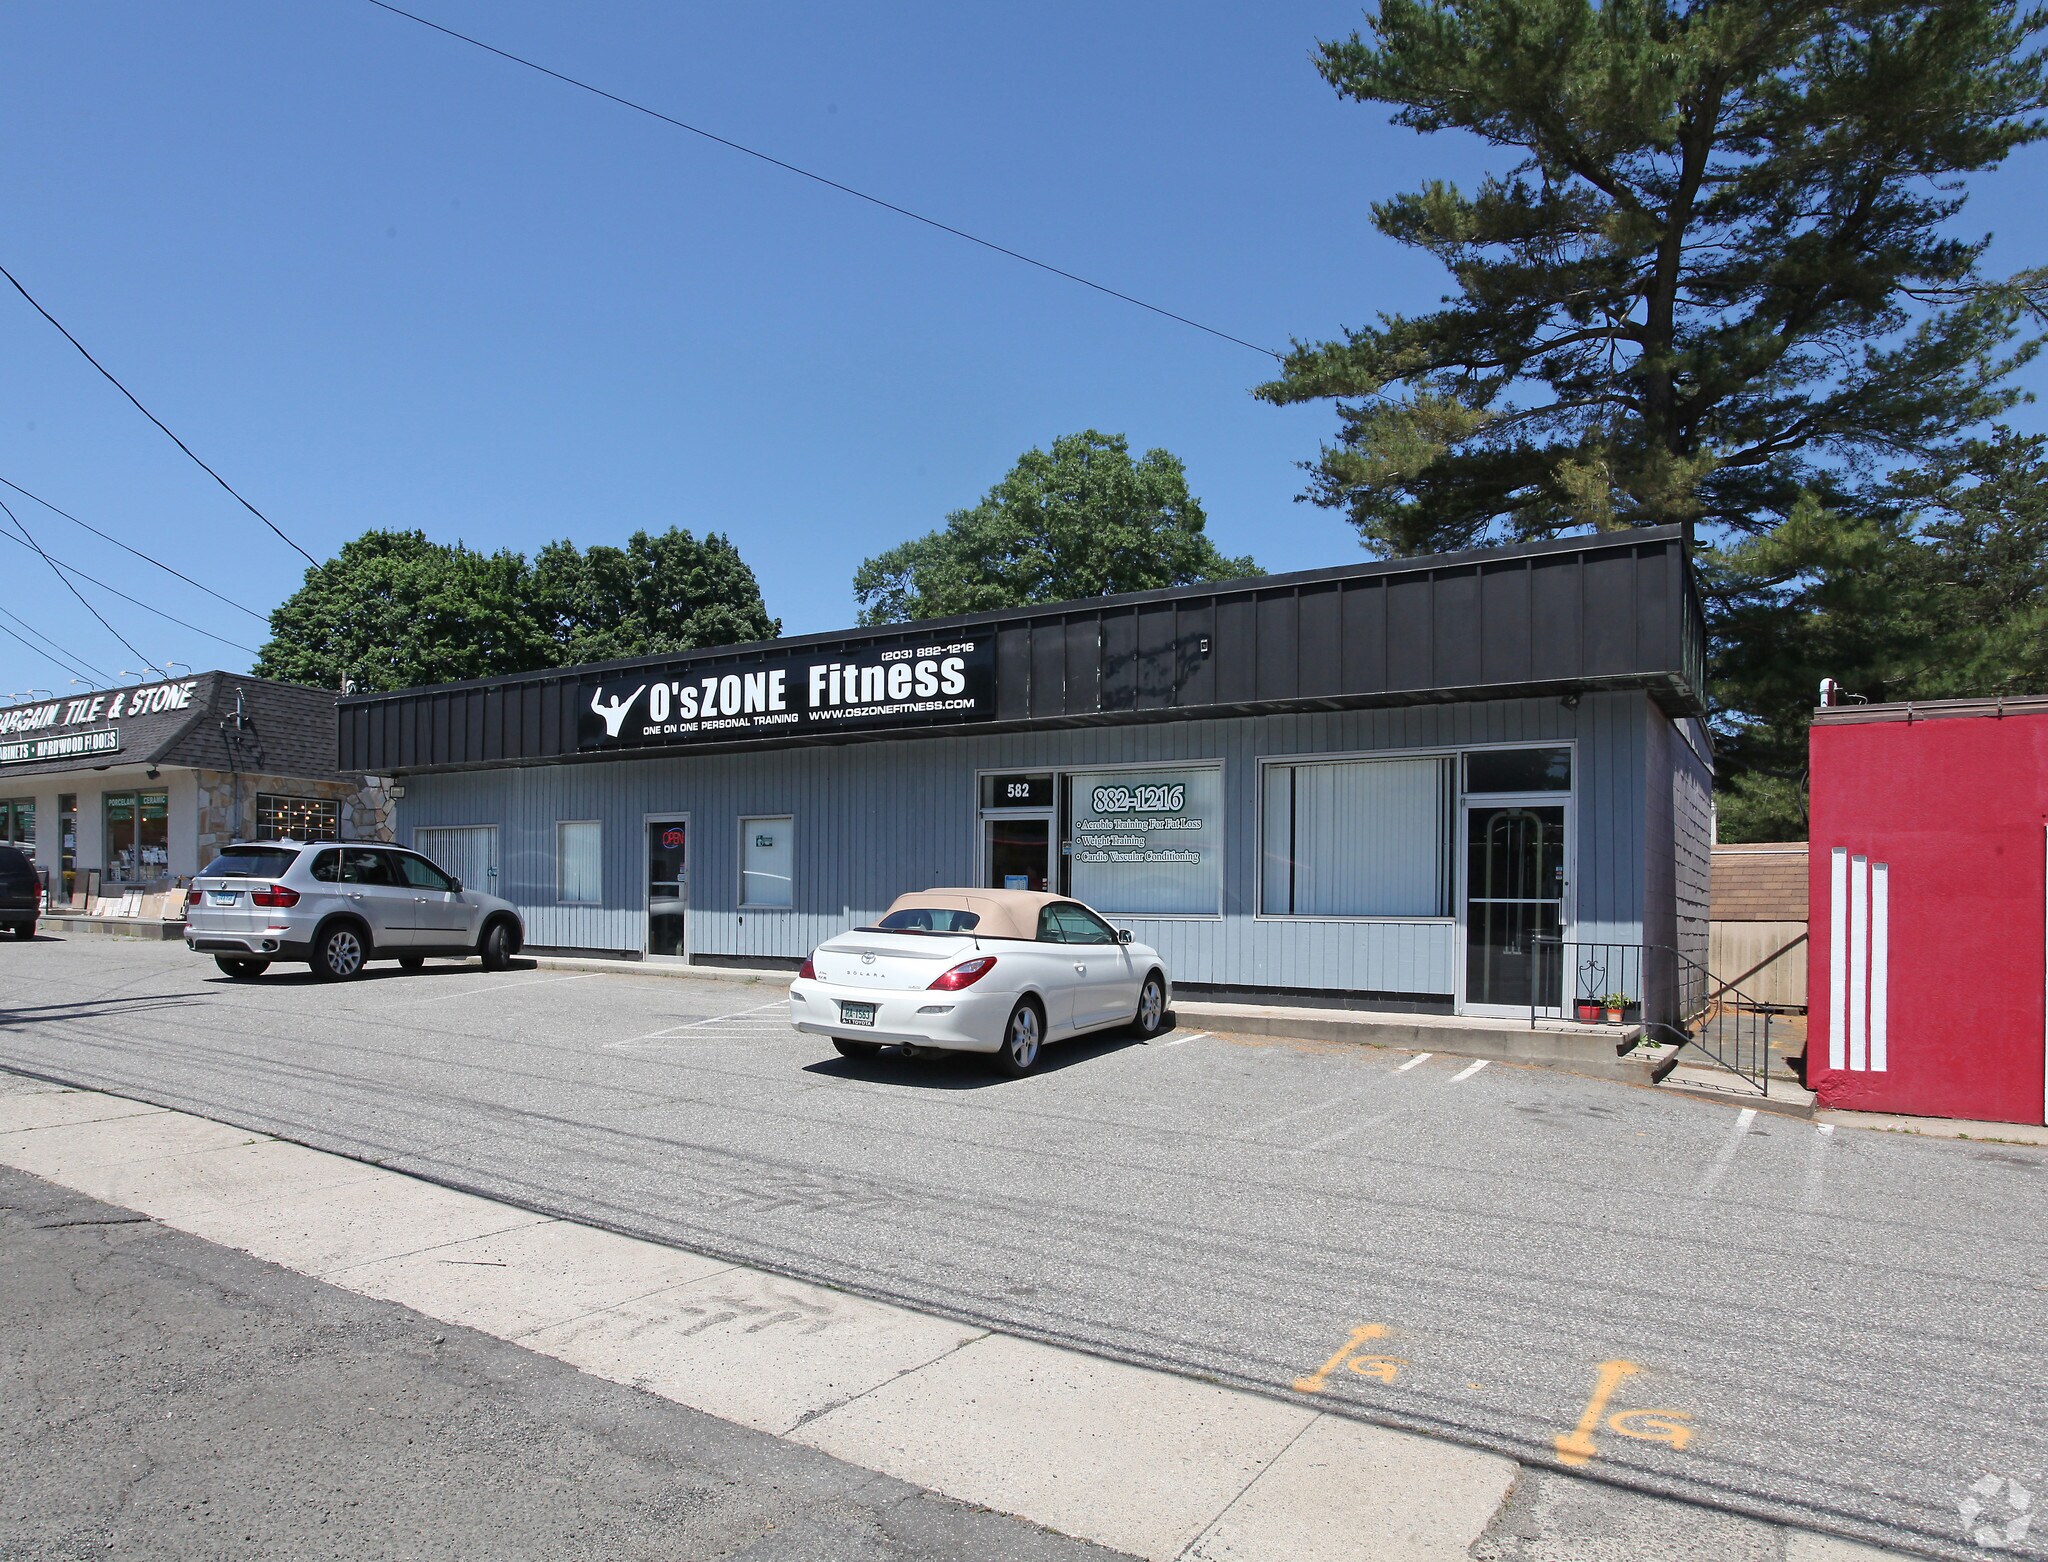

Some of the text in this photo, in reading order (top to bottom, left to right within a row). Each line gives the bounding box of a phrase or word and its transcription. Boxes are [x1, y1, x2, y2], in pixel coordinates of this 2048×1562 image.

[881, 642, 974, 661] (203) 882-1216
[649, 657, 966, 722] O'sZONE Fitness
[61, 695, 105, 726] TILE
[108, 692, 126, 720] &
[127, 681, 197, 717] STONE
[808, 698, 975, 721] WWW.OSZONEFITNESS.COM
[643, 713, 799, 735] ONE ON ONE PERSONAL TRAINING
[37, 735, 83, 757] HARDWOOD
[1007, 783, 1030, 798] 582
[108, 795, 166, 806] PORCELAIN CERAMIC
[1092, 784, 1185, 813] 882-1216
[1080, 817, 1202, 832] Aerobic Training For Fat Loss
[662, 831, 685, 845] OPEN
[1081, 834, 1146, 849] Weight Training
[1081, 849, 1201, 864] Cardio Vascular Conditioning
[846, 970, 886, 979] SOLARA
[852, 1019, 872, 1027] TOYOTA
